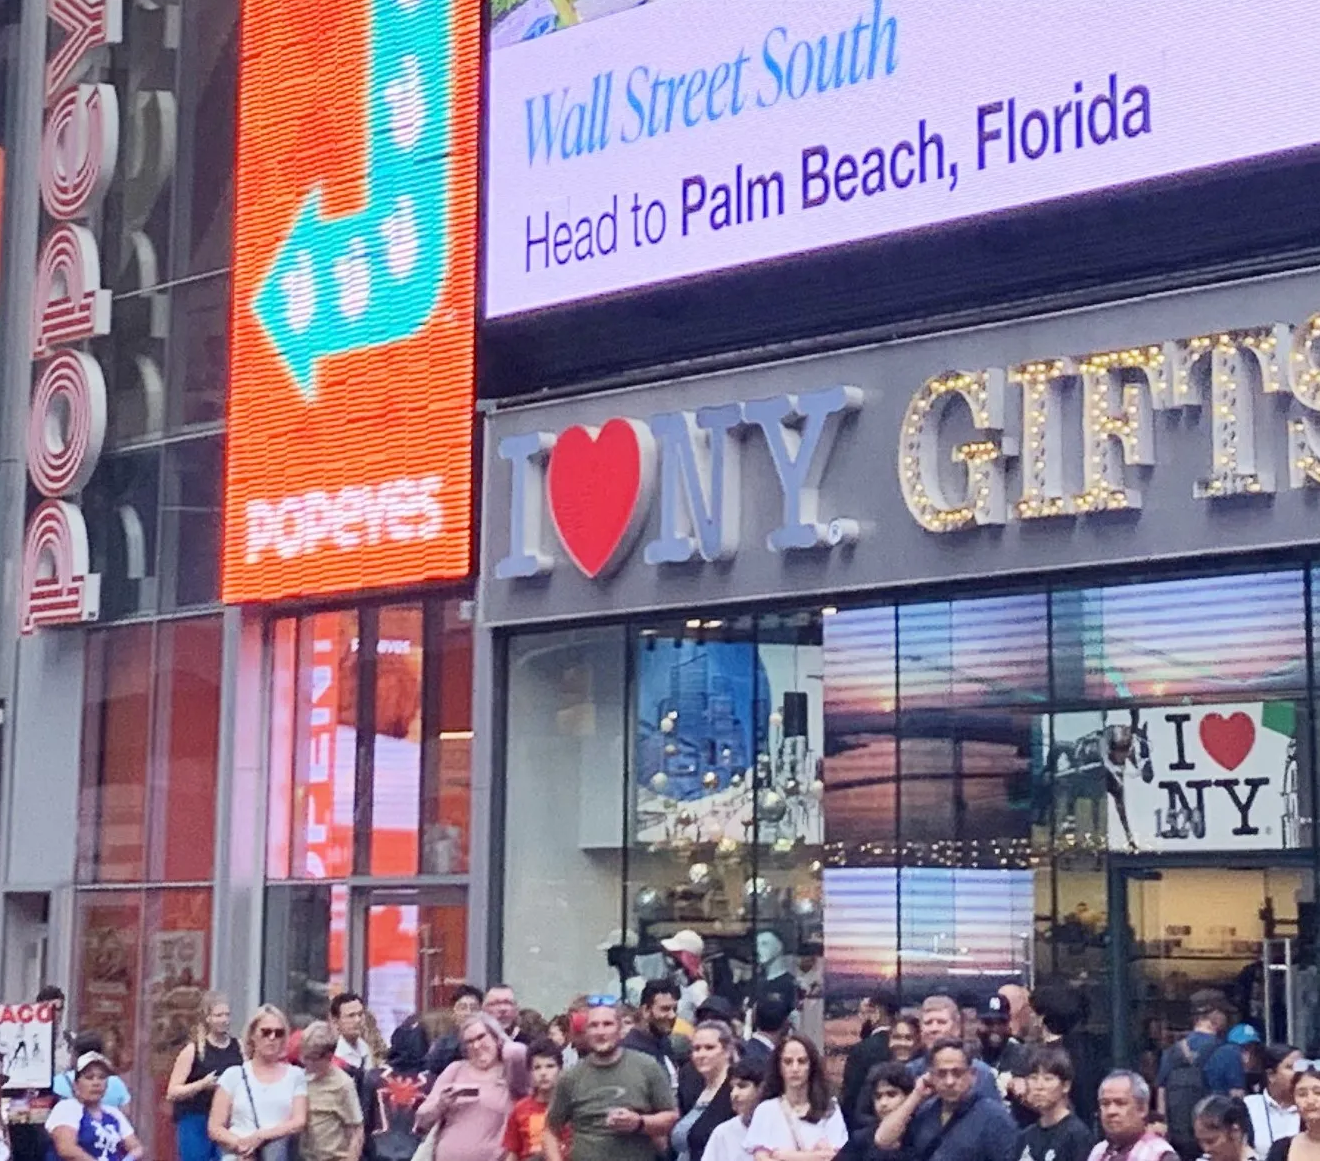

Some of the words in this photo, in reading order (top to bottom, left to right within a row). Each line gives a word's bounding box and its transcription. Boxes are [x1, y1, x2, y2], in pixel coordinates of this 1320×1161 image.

[525, 71, 613, 168] Wall
[620, 48, 751, 143] Street
[525, 195, 618, 272] Head
[632, 194, 666, 250] to
[681, 163, 785, 236] Palm
[801, 119, 959, 210] Beach,
[977, 73, 1152, 170] Florida
